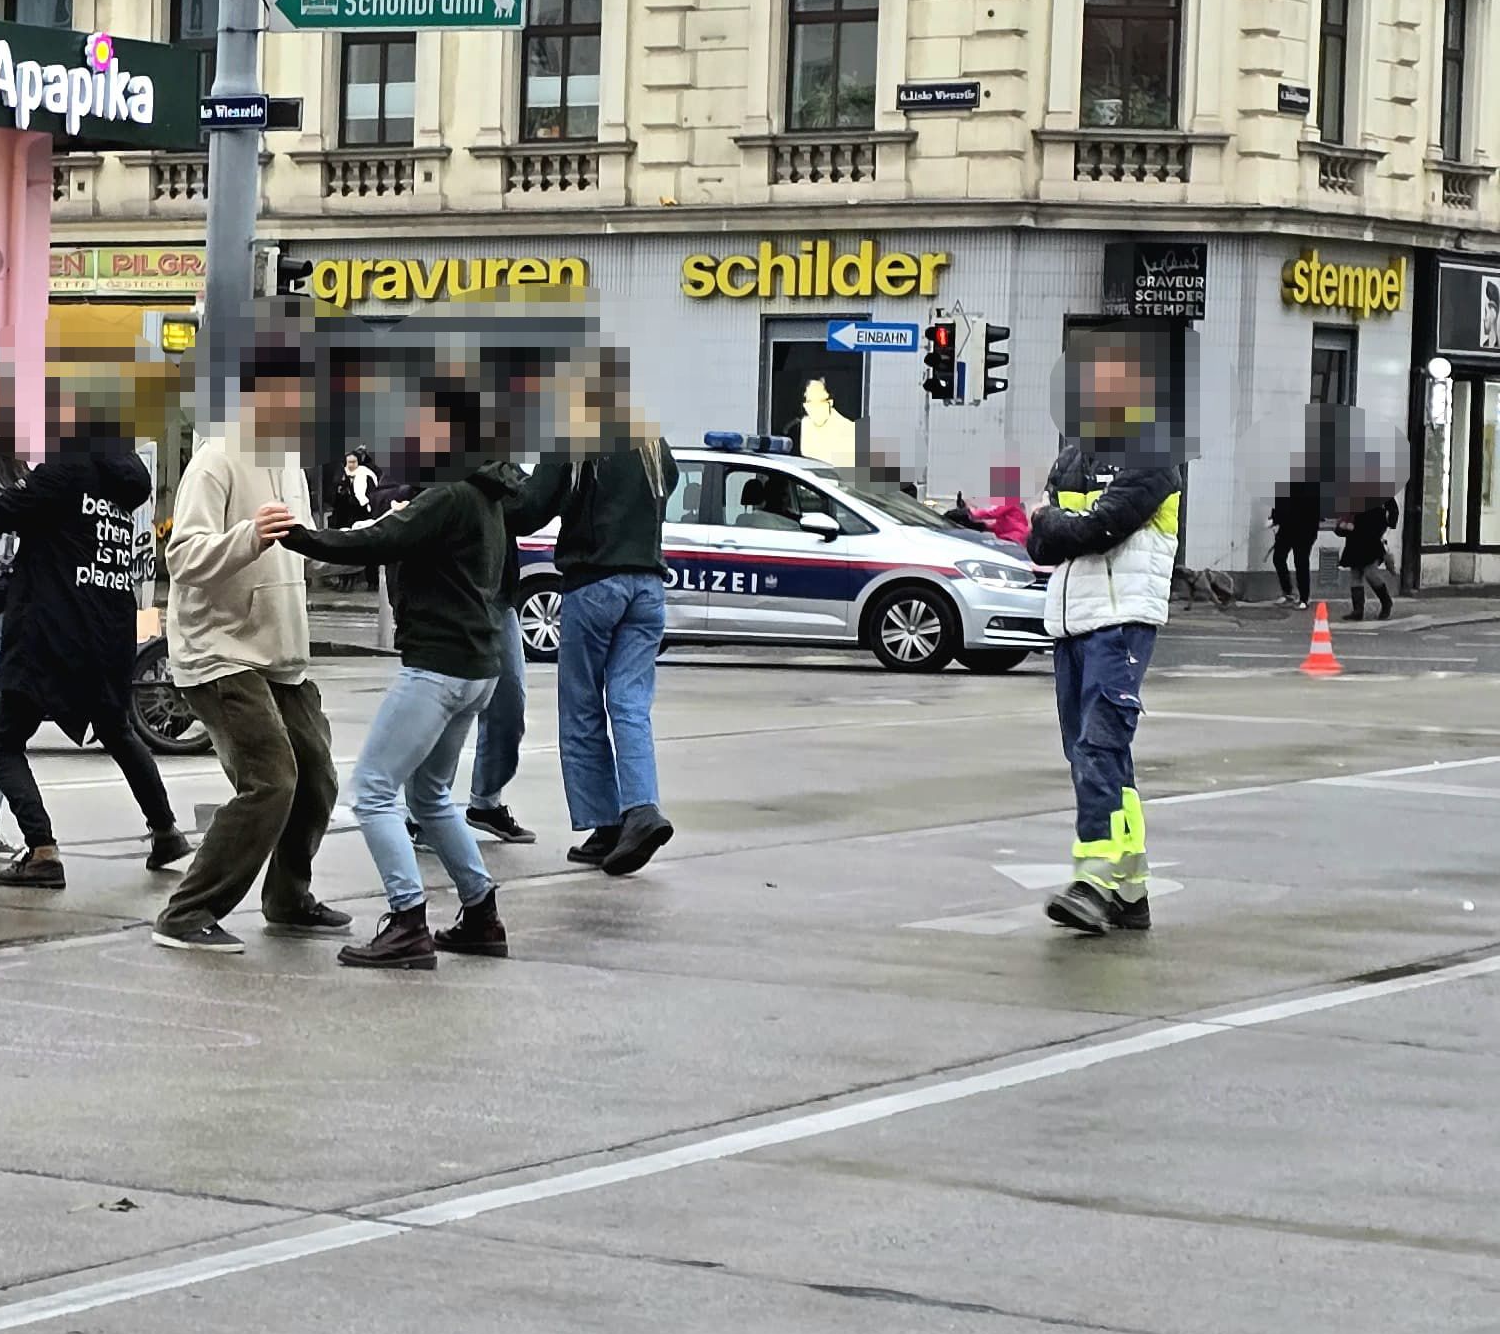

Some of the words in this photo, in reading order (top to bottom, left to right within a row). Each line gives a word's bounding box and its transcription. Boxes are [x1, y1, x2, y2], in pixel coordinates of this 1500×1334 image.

[49, 251, 86, 277] EN
[681, 240, 948, 298] schilder
[312, 257, 586, 309] gravuren
[1136, 275, 1204, 288] GRAVEUR
[1293, 249, 1407, 319] stempel
[1135, 290, 1204, 302] SCHILDER
[1135, 304, 1203, 316] STEMPEL
[856, 330, 908, 344] EINBAHN
[96, 518, 131, 546] there
[96, 542, 113, 564] is
[116, 548, 131, 567] no
[75, 562, 130, 591] planet
[663, 567, 758, 594] OLIZEI
